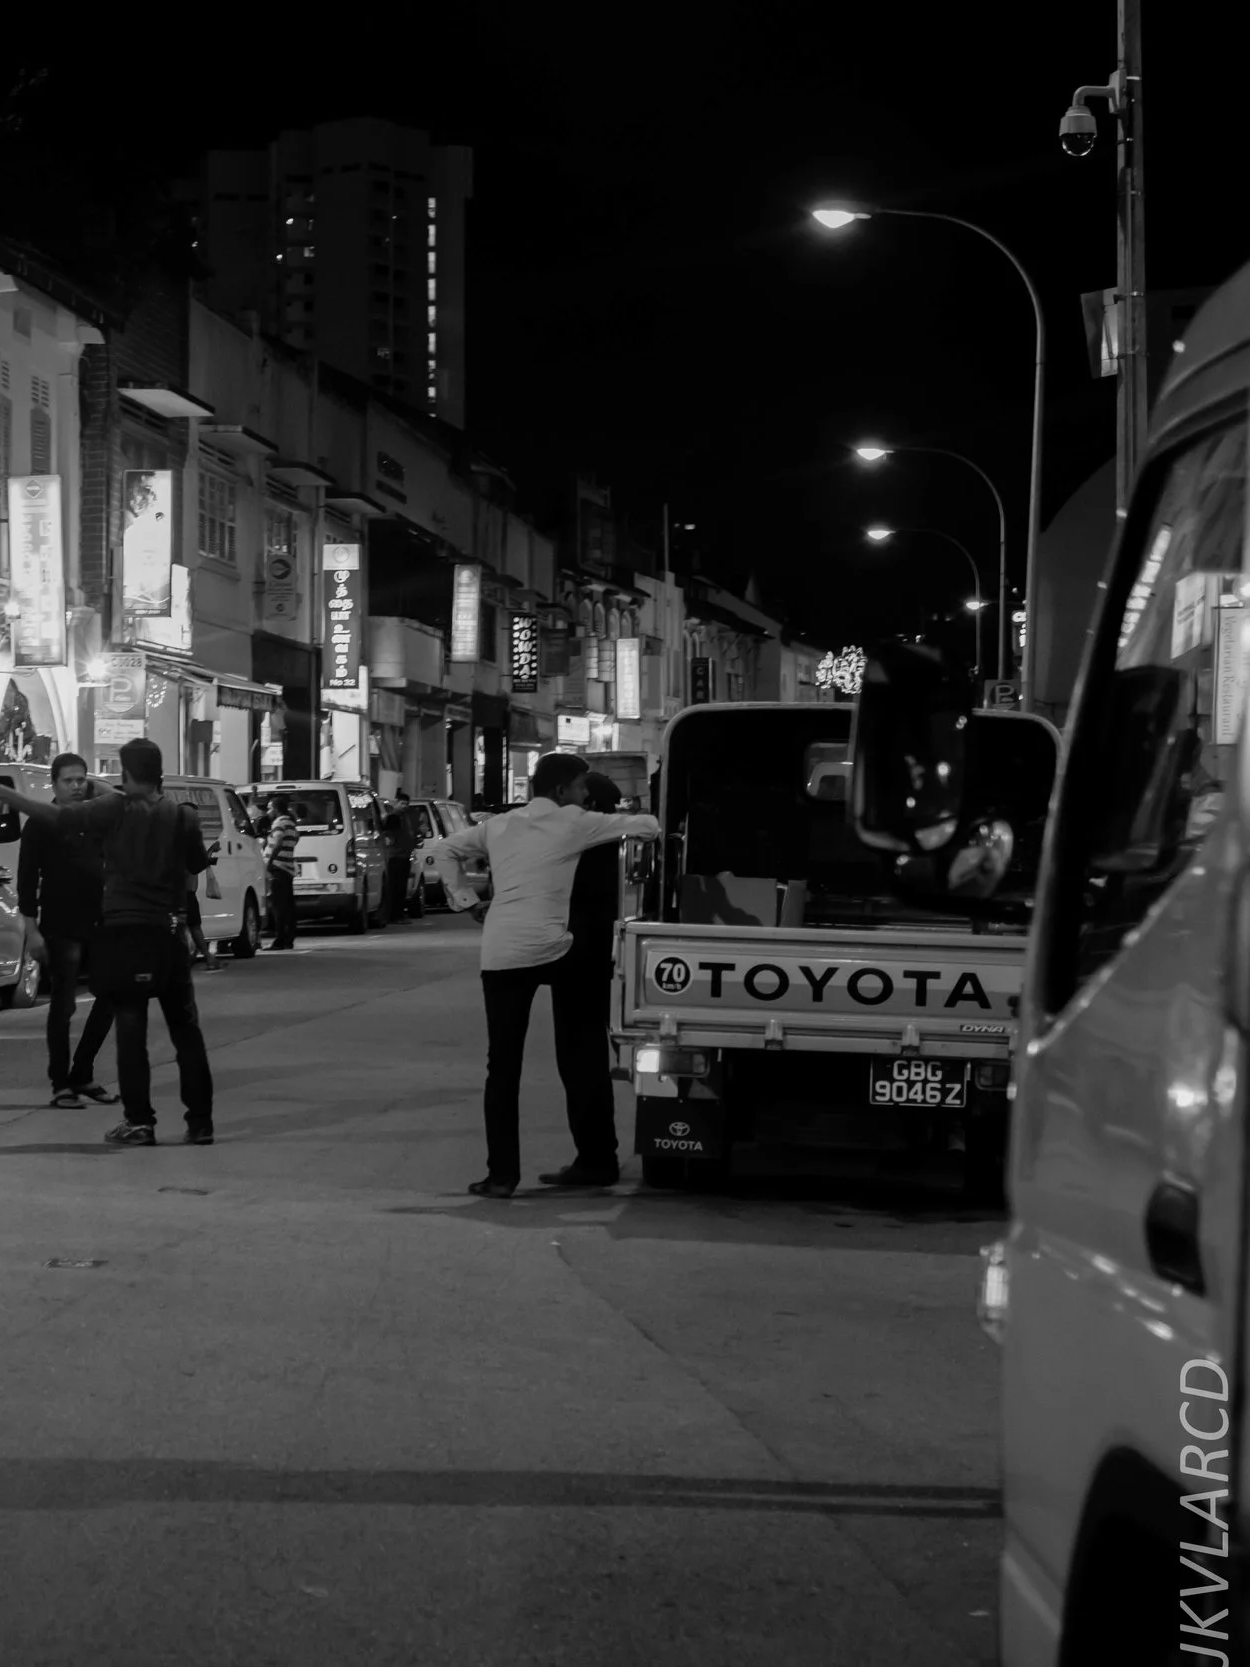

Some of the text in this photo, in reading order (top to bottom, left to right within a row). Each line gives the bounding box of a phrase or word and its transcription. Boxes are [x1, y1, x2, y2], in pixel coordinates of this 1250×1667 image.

[659, 962, 686, 983] 70
[698, 961, 992, 1010] TOYOTA
[961, 1024, 1004, 1033] DYNA
[892, 1059, 944, 1082] GBG
[873, 1081, 963, 1105] 9046Z
[653, 1138, 704, 1152] TOYOTA
